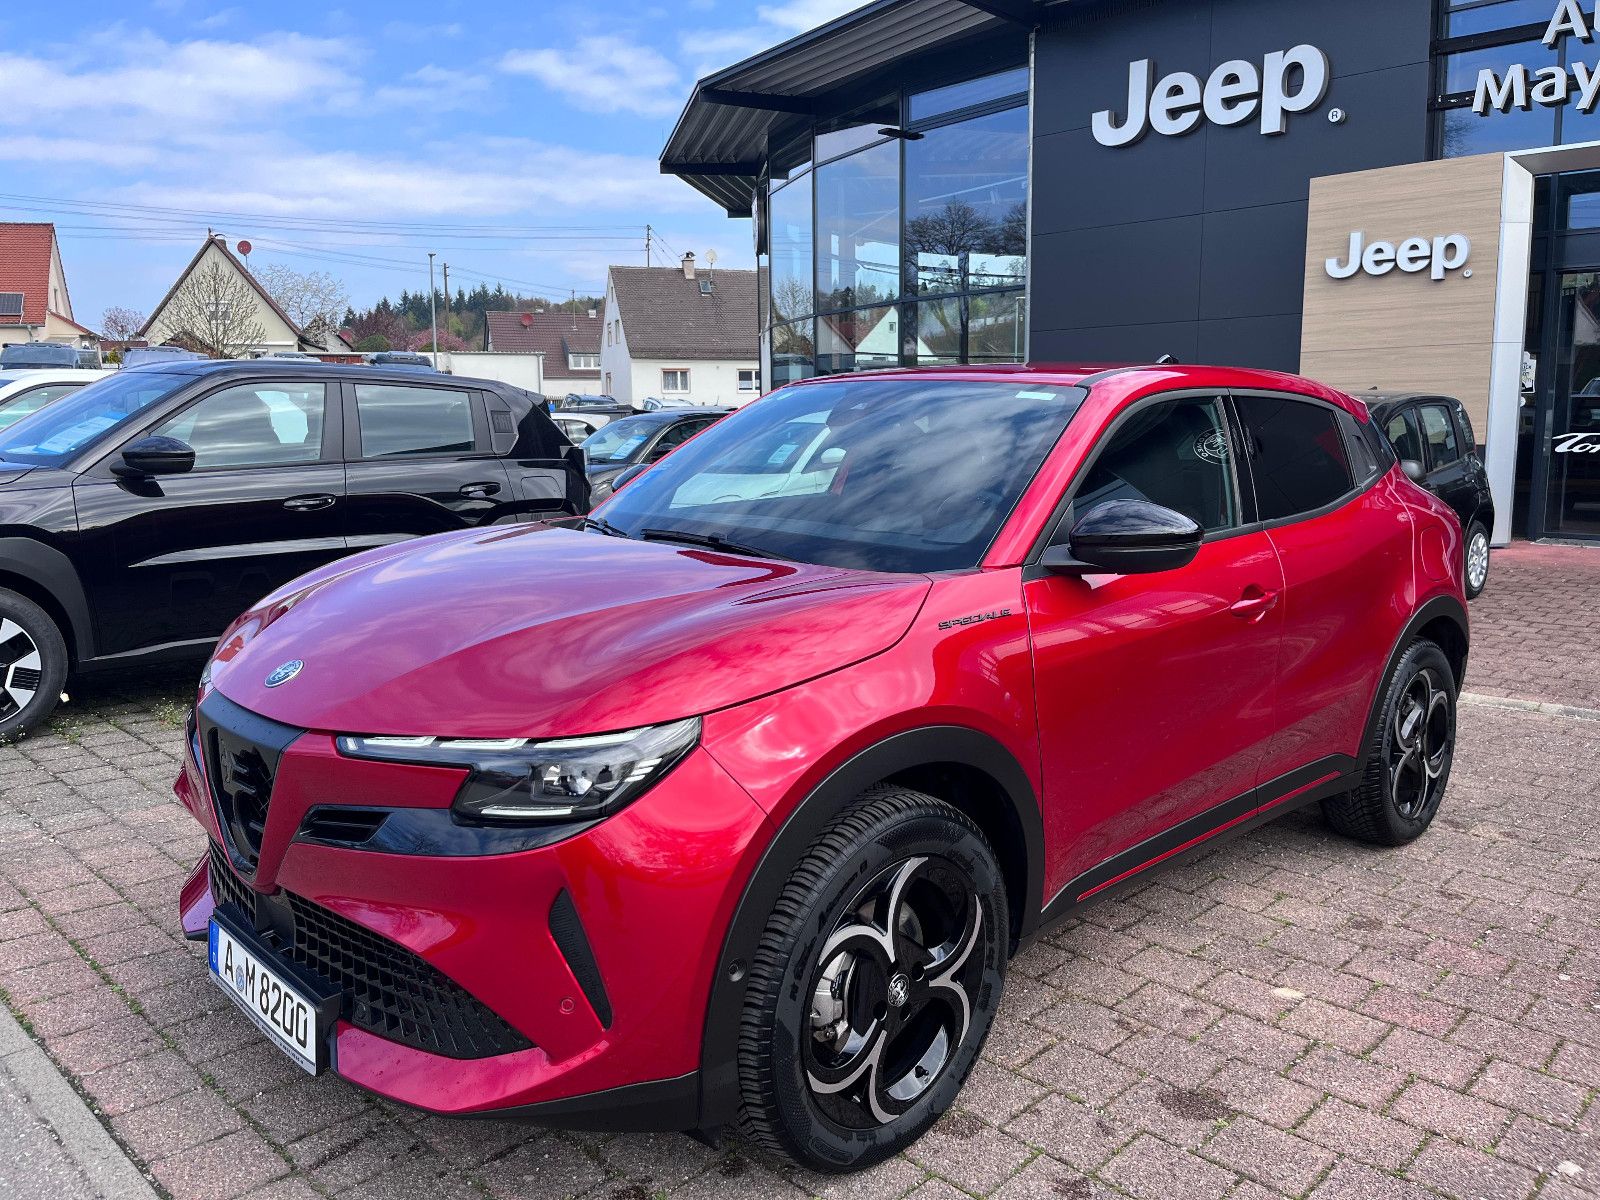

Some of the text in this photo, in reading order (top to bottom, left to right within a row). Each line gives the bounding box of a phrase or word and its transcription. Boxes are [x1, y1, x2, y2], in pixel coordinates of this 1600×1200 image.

[1091, 44, 1330, 147] Jeep
[1472, 60, 1600, 113] May
[1325, 230, 1471, 281] Jeep
[938, 608, 1012, 631] SPECIALE
[224, 939, 234, 982] A
[245, 956, 256, 1005] M
[259, 971, 308, 1049] 8200
